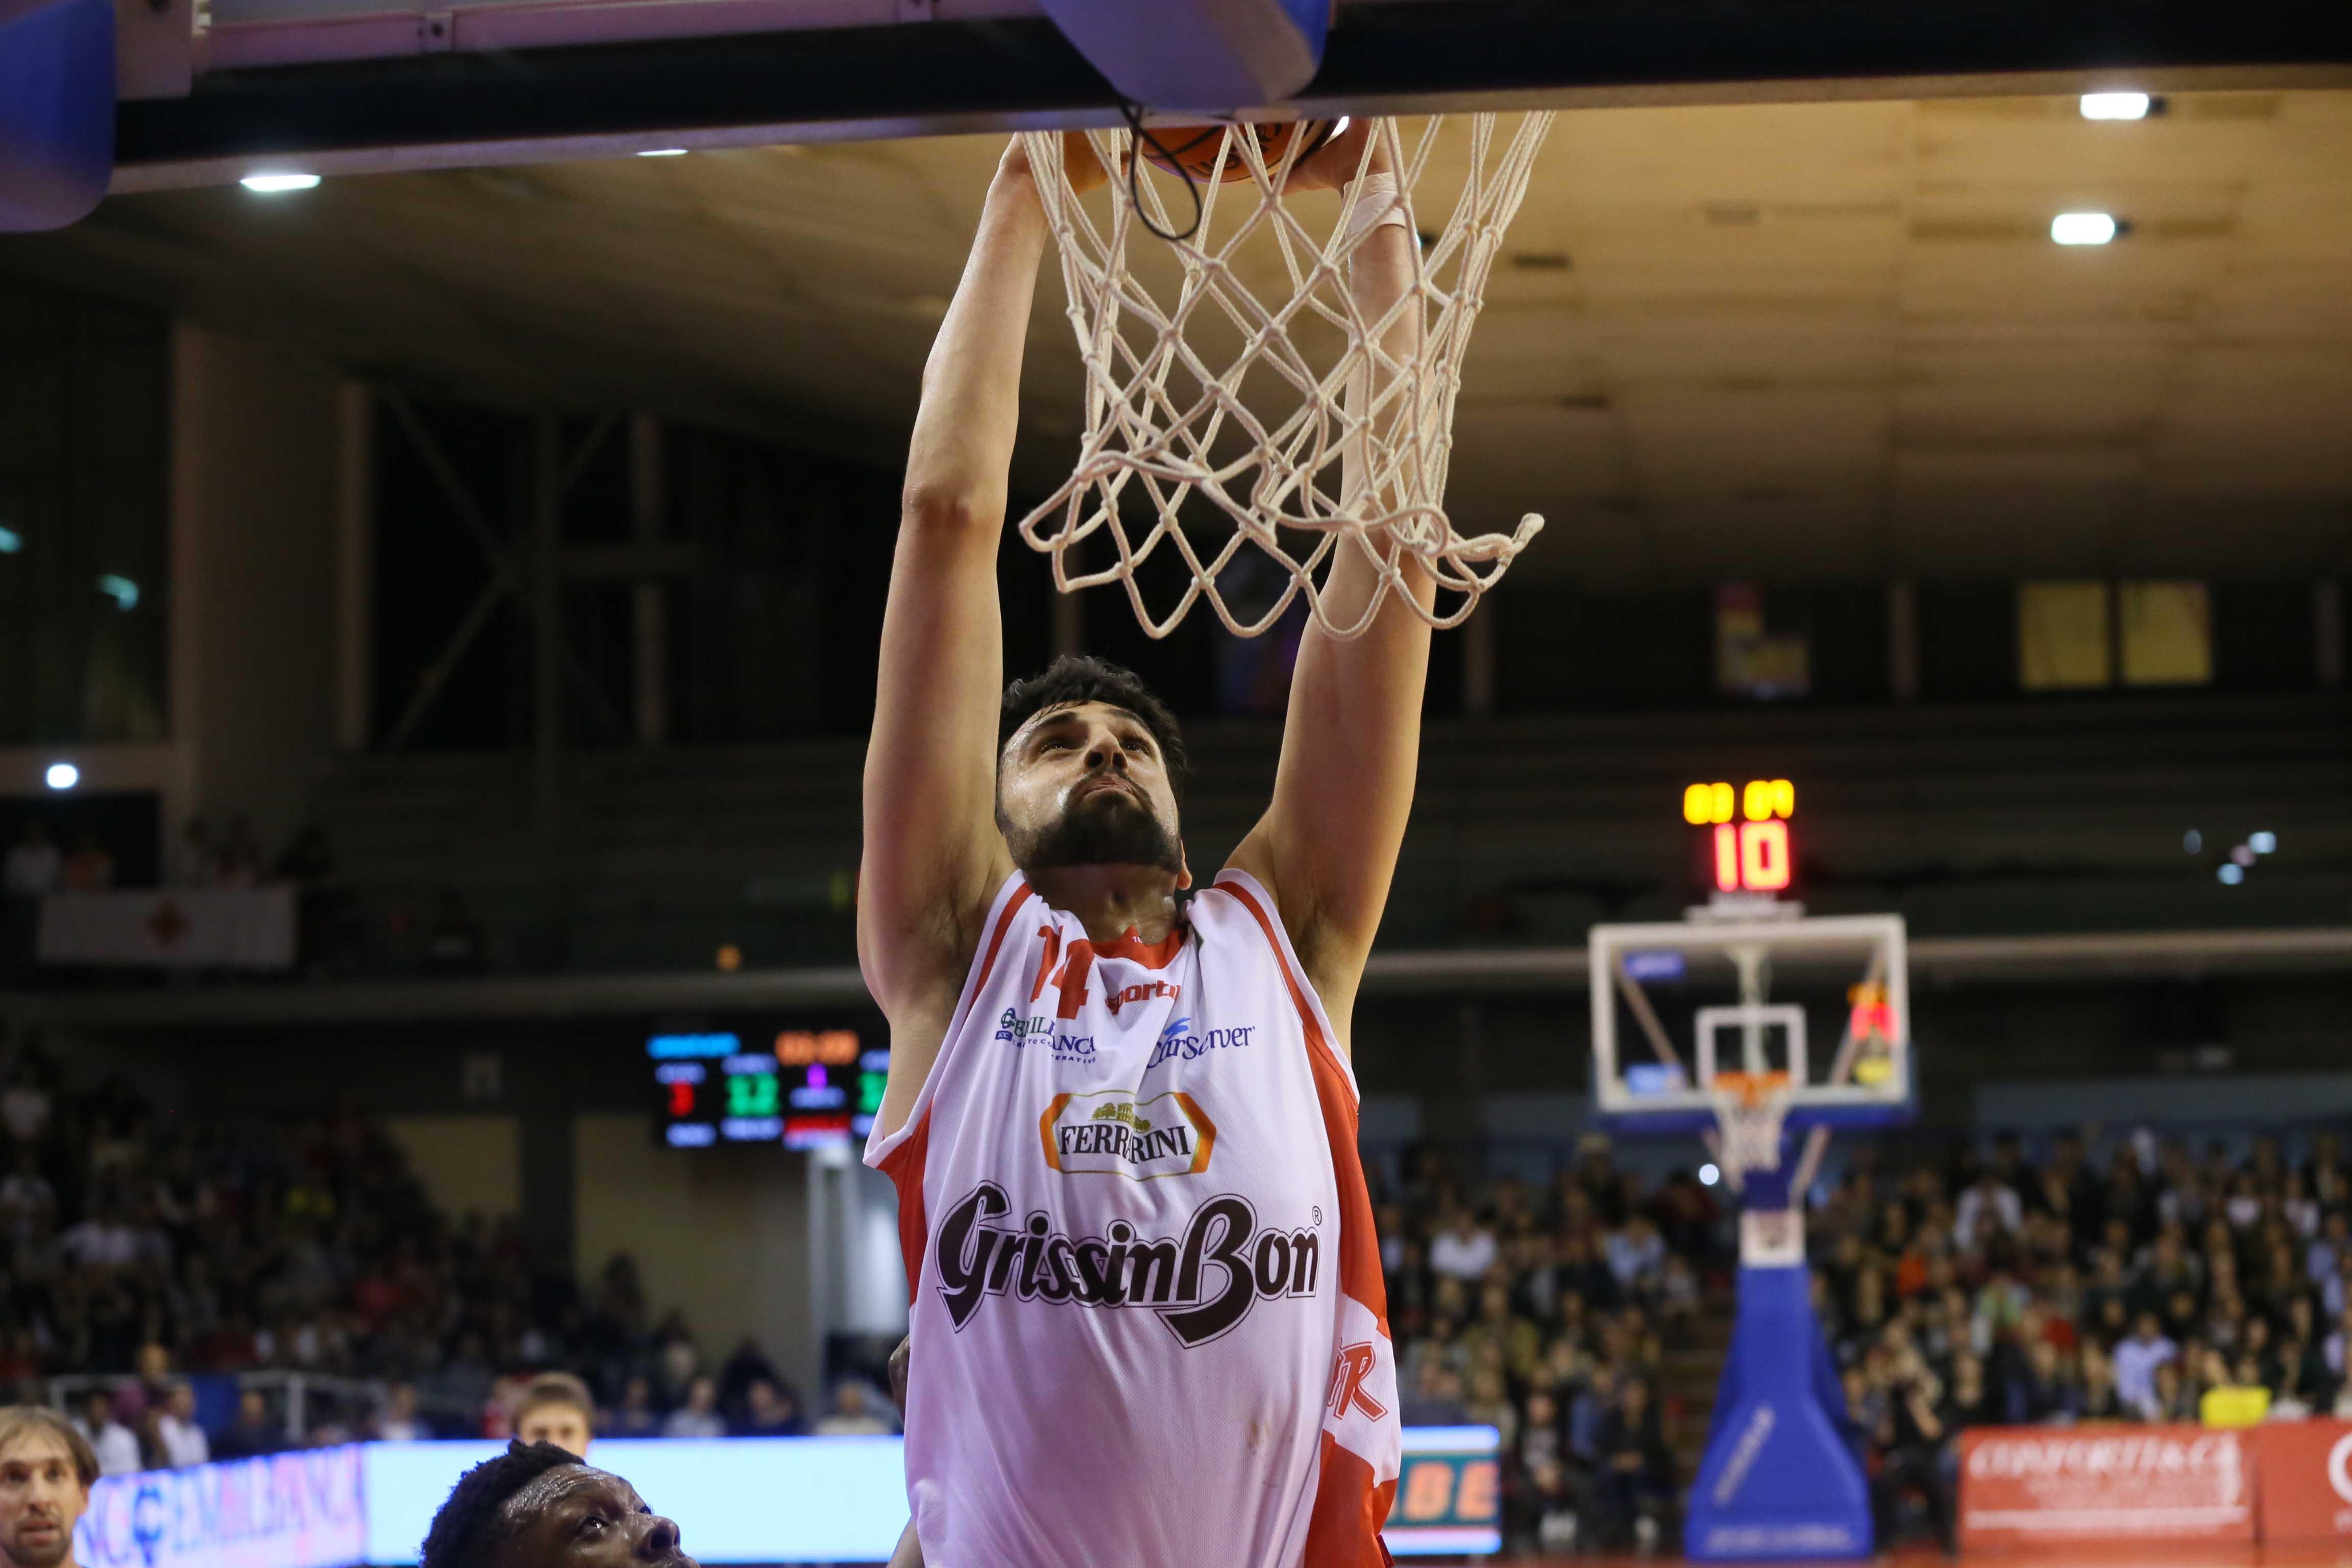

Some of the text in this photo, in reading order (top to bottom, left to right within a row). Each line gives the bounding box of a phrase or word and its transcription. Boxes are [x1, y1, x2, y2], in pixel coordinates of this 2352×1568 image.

[1714, 819, 1791, 892] 10
[1030, 925, 1094, 1020] 14
[1060, 1124, 1191, 1164] FERRRINI
[935, 1180, 1321, 1350] GrissinBon
